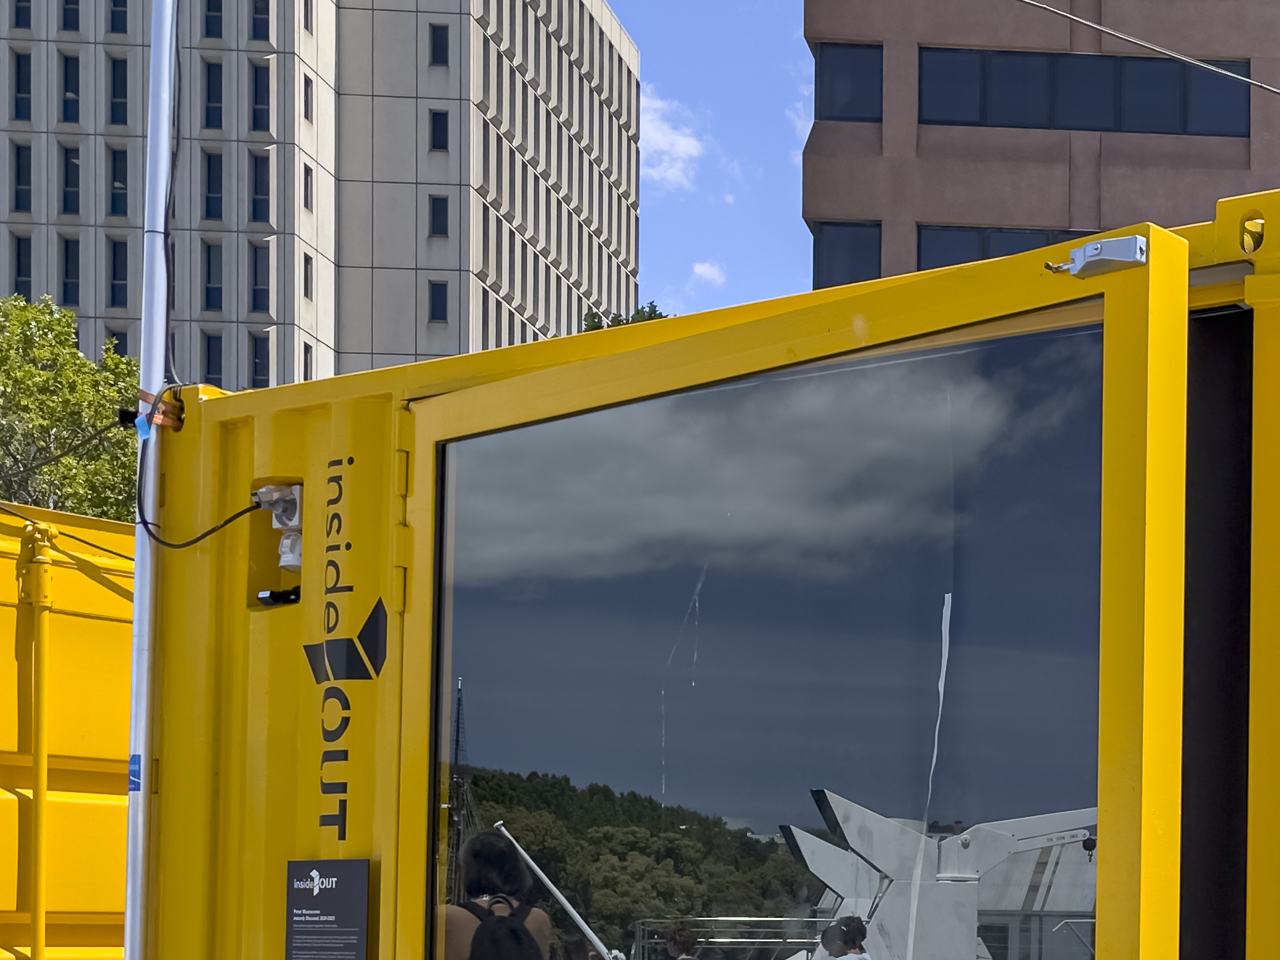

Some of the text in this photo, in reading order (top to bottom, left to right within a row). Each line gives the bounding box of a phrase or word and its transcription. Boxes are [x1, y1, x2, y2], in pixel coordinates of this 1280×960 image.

[319, 456, 354, 840] inside OUT
[319, 878, 338, 889] OUT
